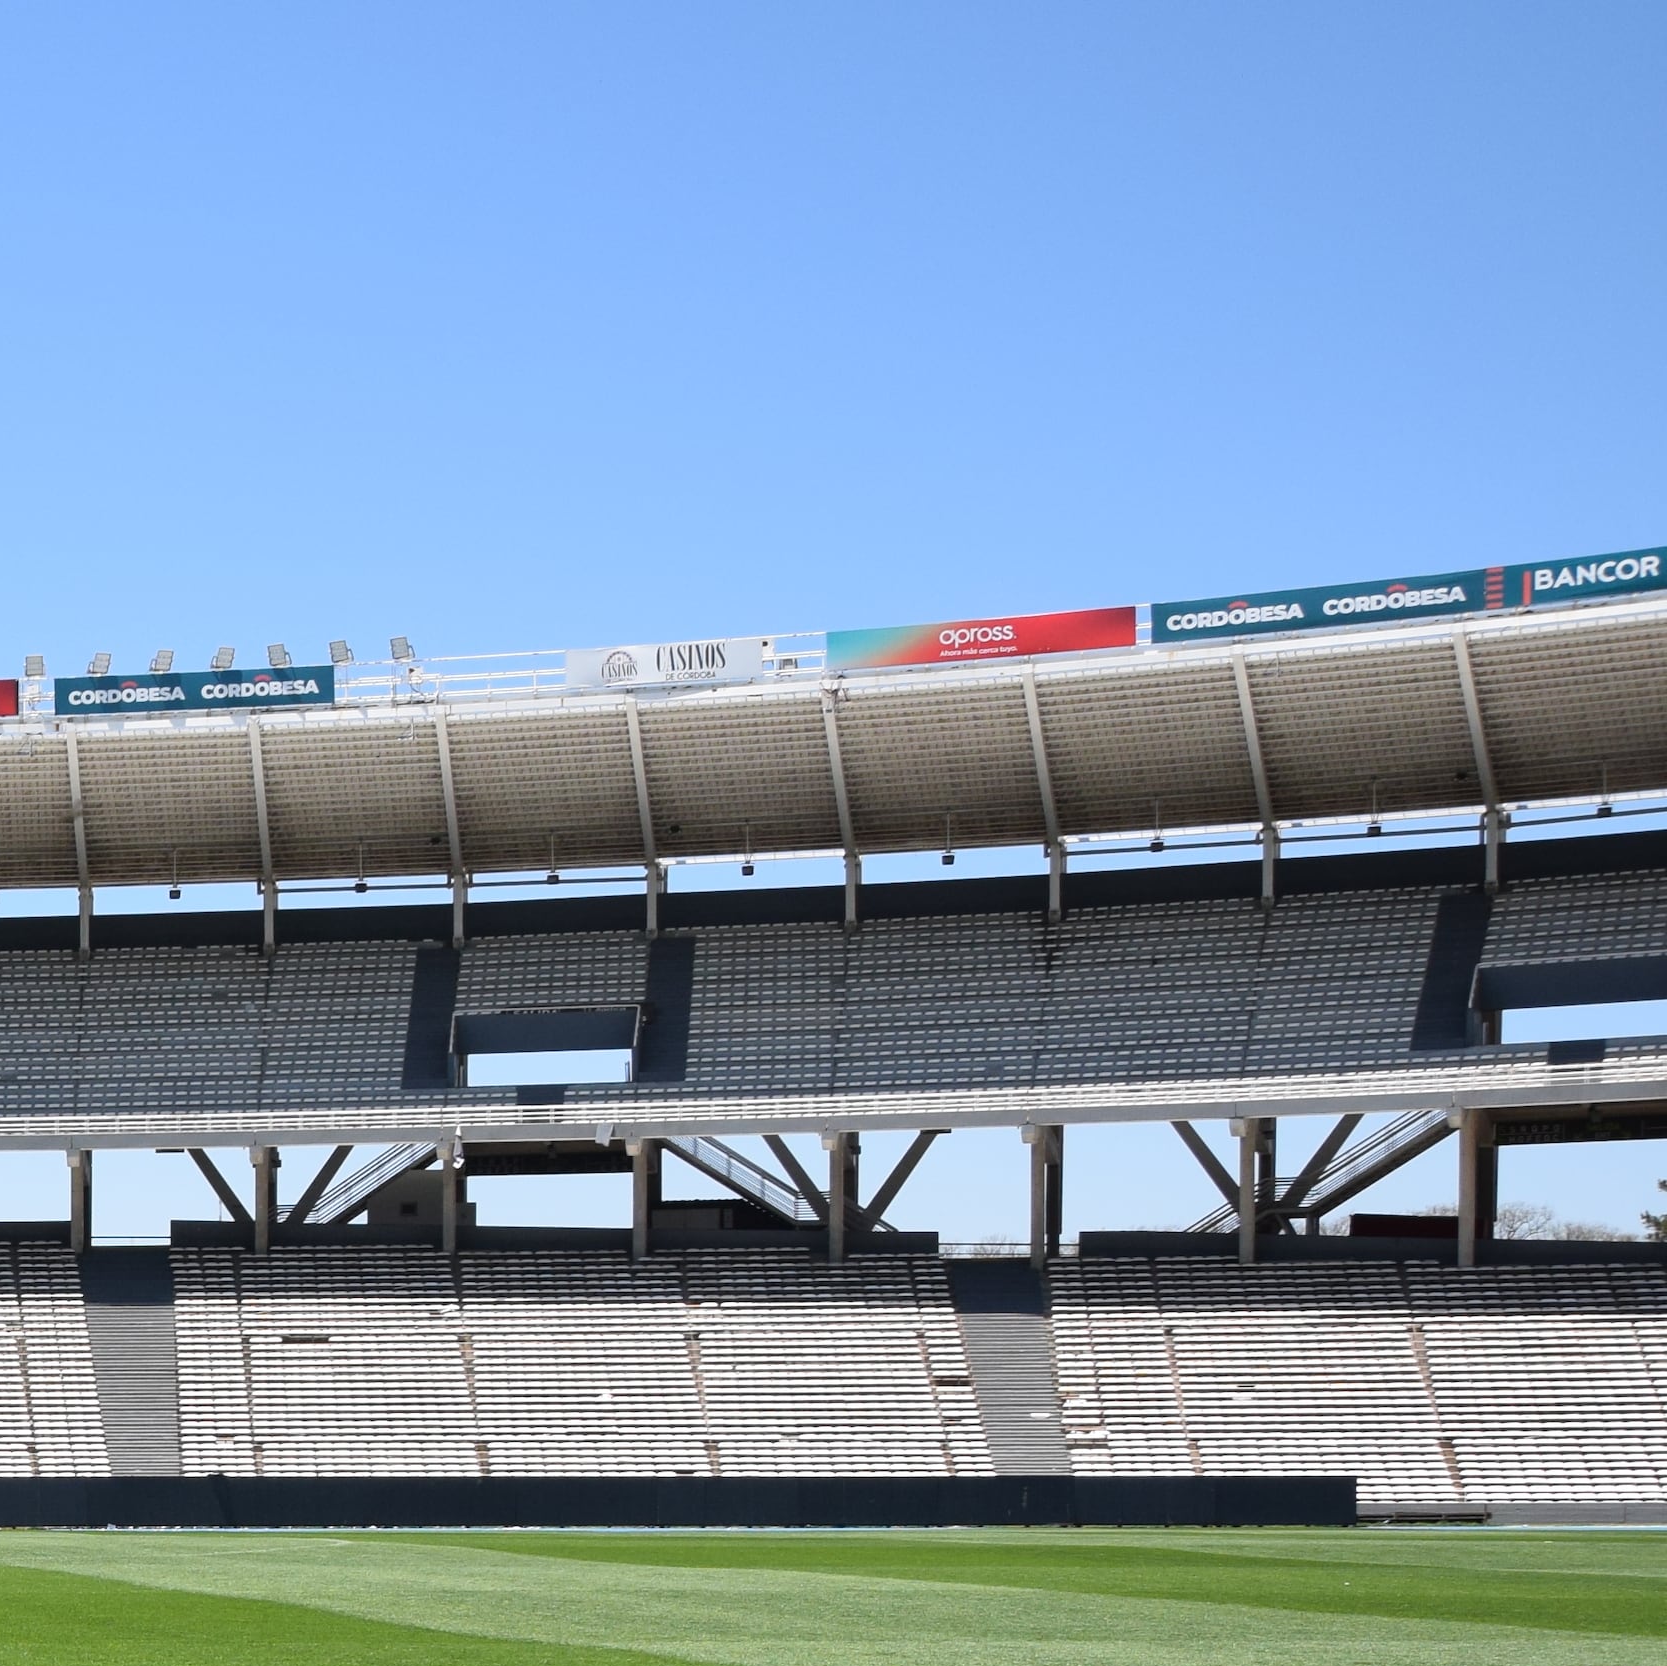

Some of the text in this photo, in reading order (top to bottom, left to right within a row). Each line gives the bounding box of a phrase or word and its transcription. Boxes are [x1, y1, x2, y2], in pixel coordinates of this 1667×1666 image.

[1534, 556, 1660, 591] BANCOR
[1166, 585, 1466, 632] CORDOBESA CORDOBESA
[656, 643, 726, 672] CASINOS
[69, 678, 320, 706] CORDOBESA CORDOBESA
